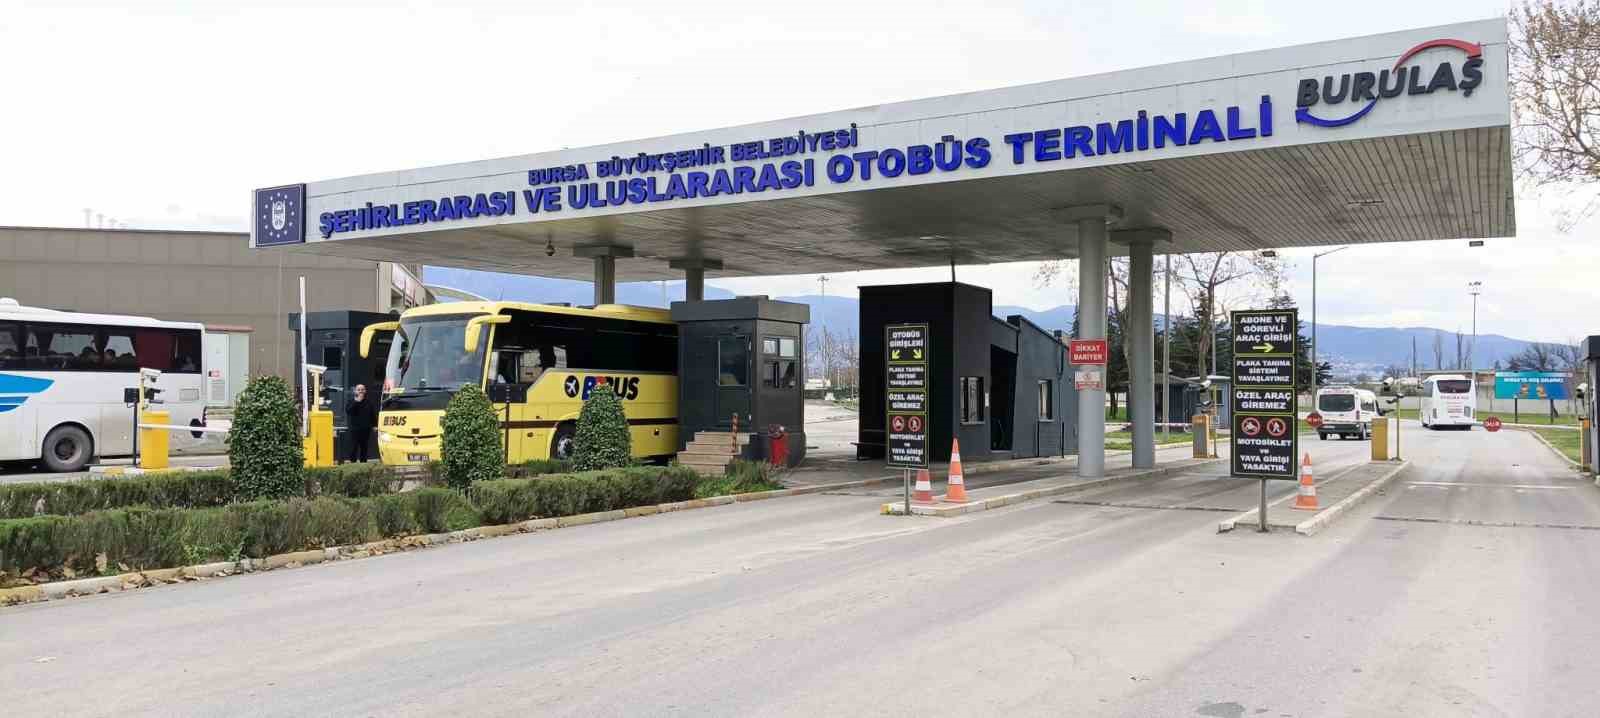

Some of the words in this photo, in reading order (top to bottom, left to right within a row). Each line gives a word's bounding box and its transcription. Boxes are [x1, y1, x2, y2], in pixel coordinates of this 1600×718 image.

[1296, 58, 1484, 107] BURULAŞ
[528, 162, 590, 186] BURSA
[597, 142, 725, 173] BÜYÜKŞEHİR
[731, 122, 858, 162] BELEDİYESİ
[319, 190, 515, 239] ŞEHİRLERARASI
[525, 186, 562, 213] VE
[568, 157, 816, 211] ULUSLARARASI
[827, 136, 991, 185] OTOBÜS
[1005, 95, 1274, 165] TERMİNALİ
[1240, 316, 1272, 324] ABONE
[1243, 324, 1284, 333] GÖREVLİ
[1236, 334, 1261, 343] ARAÇ
[1263, 333, 1292, 343] GİRİŞİ
[1236, 391, 1262, 399] ÖZEL
[1264, 392, 1292, 400] ARAÇ
[1241, 400, 1287, 409] GİREMEZ
[1237, 438, 1292, 446] MOTOSİKLET
